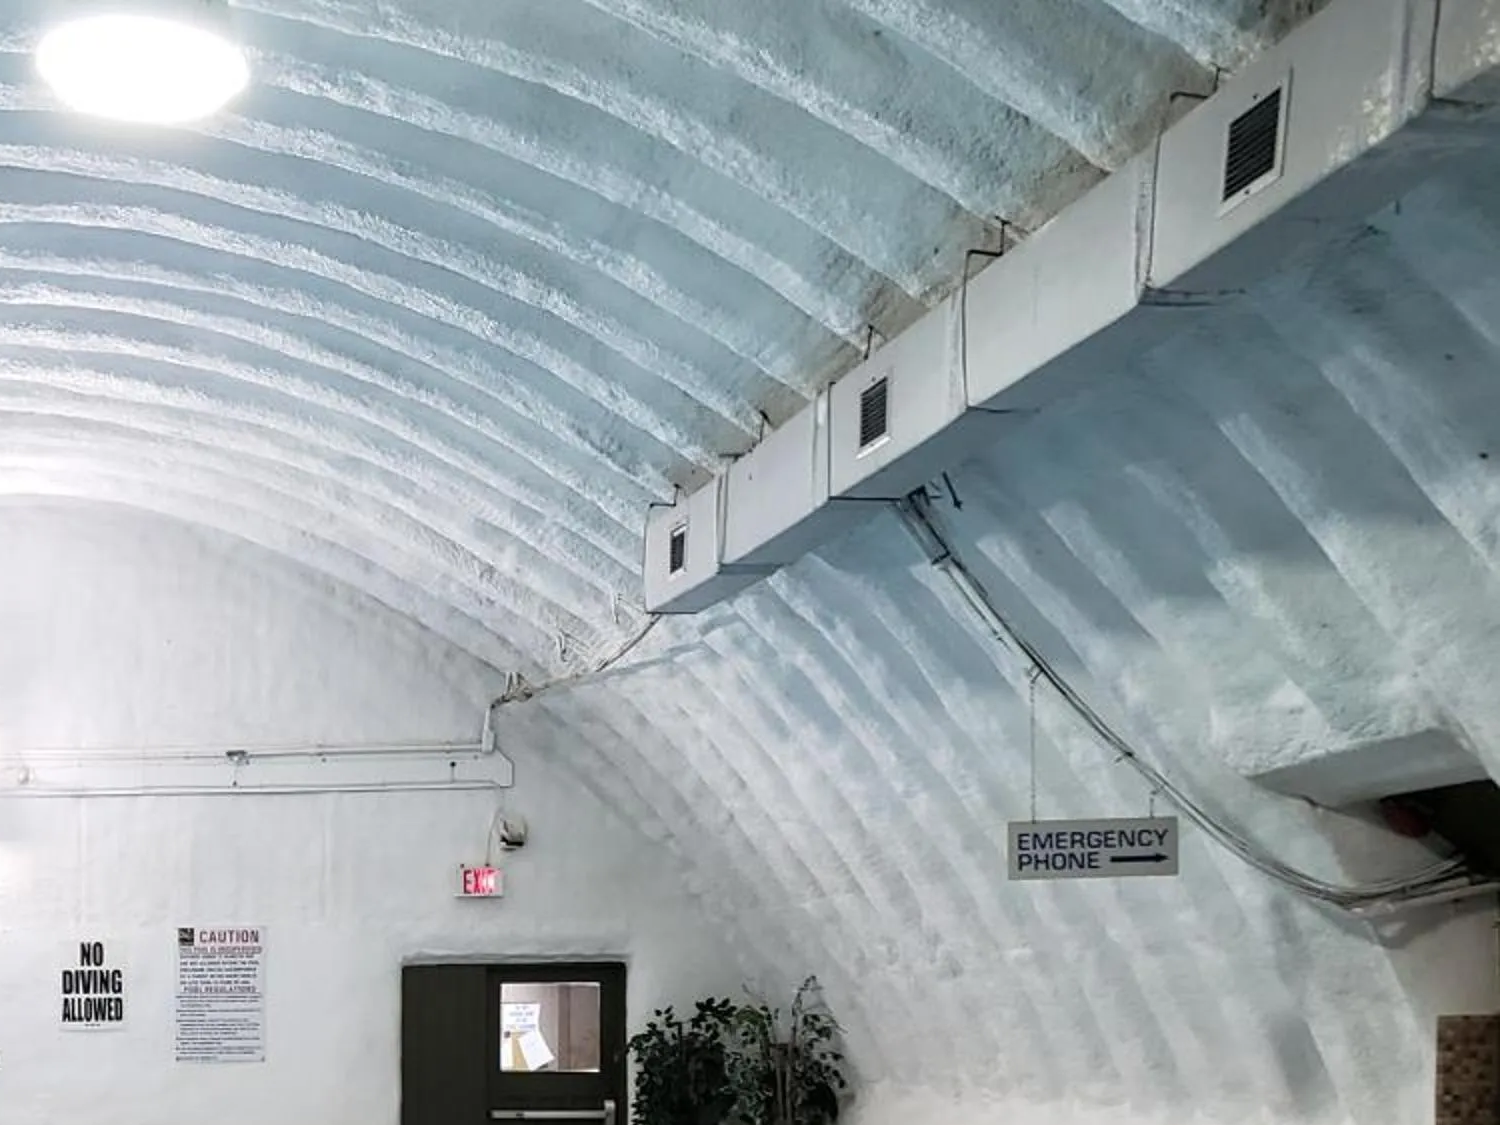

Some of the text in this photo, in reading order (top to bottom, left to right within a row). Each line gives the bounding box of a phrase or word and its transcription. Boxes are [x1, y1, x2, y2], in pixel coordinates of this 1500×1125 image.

[1017, 829, 1169, 851] EMERGENCY
[1017, 852, 1102, 872] PHONE
[463, 869, 495, 894] EXIT
[199, 929, 259, 943] CAUTION
[80, 942, 104, 967] NO
[62, 969, 123, 994] DIVING
[61, 997, 123, 1022] ALLOWED
